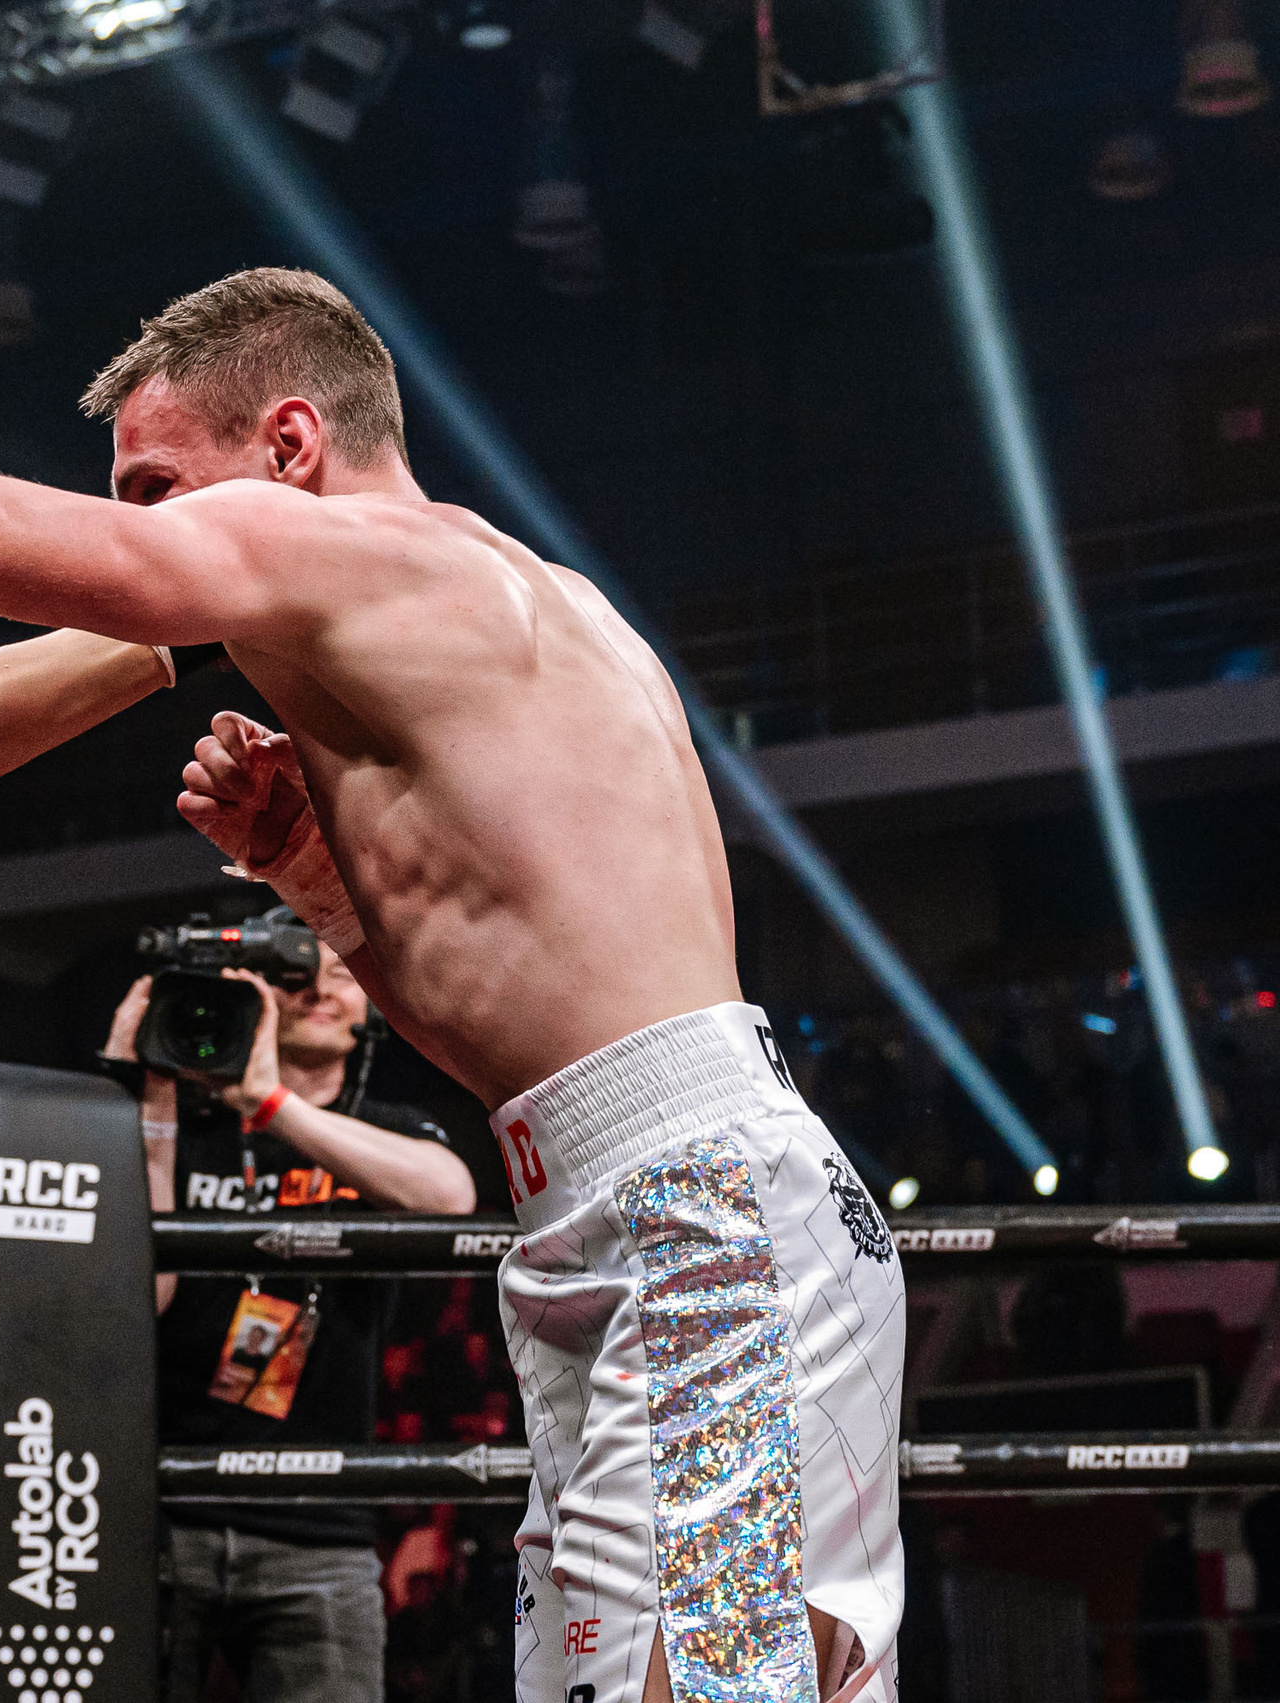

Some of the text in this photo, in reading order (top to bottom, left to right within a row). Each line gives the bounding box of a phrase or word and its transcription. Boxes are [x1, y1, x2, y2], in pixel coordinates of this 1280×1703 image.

[891, 1229, 930, 1250] CC
[4, 1397, 54, 1609] Autolab
[1067, 1445, 1124, 1470] RCC
[55, 1451, 100, 1610] BY RCC
